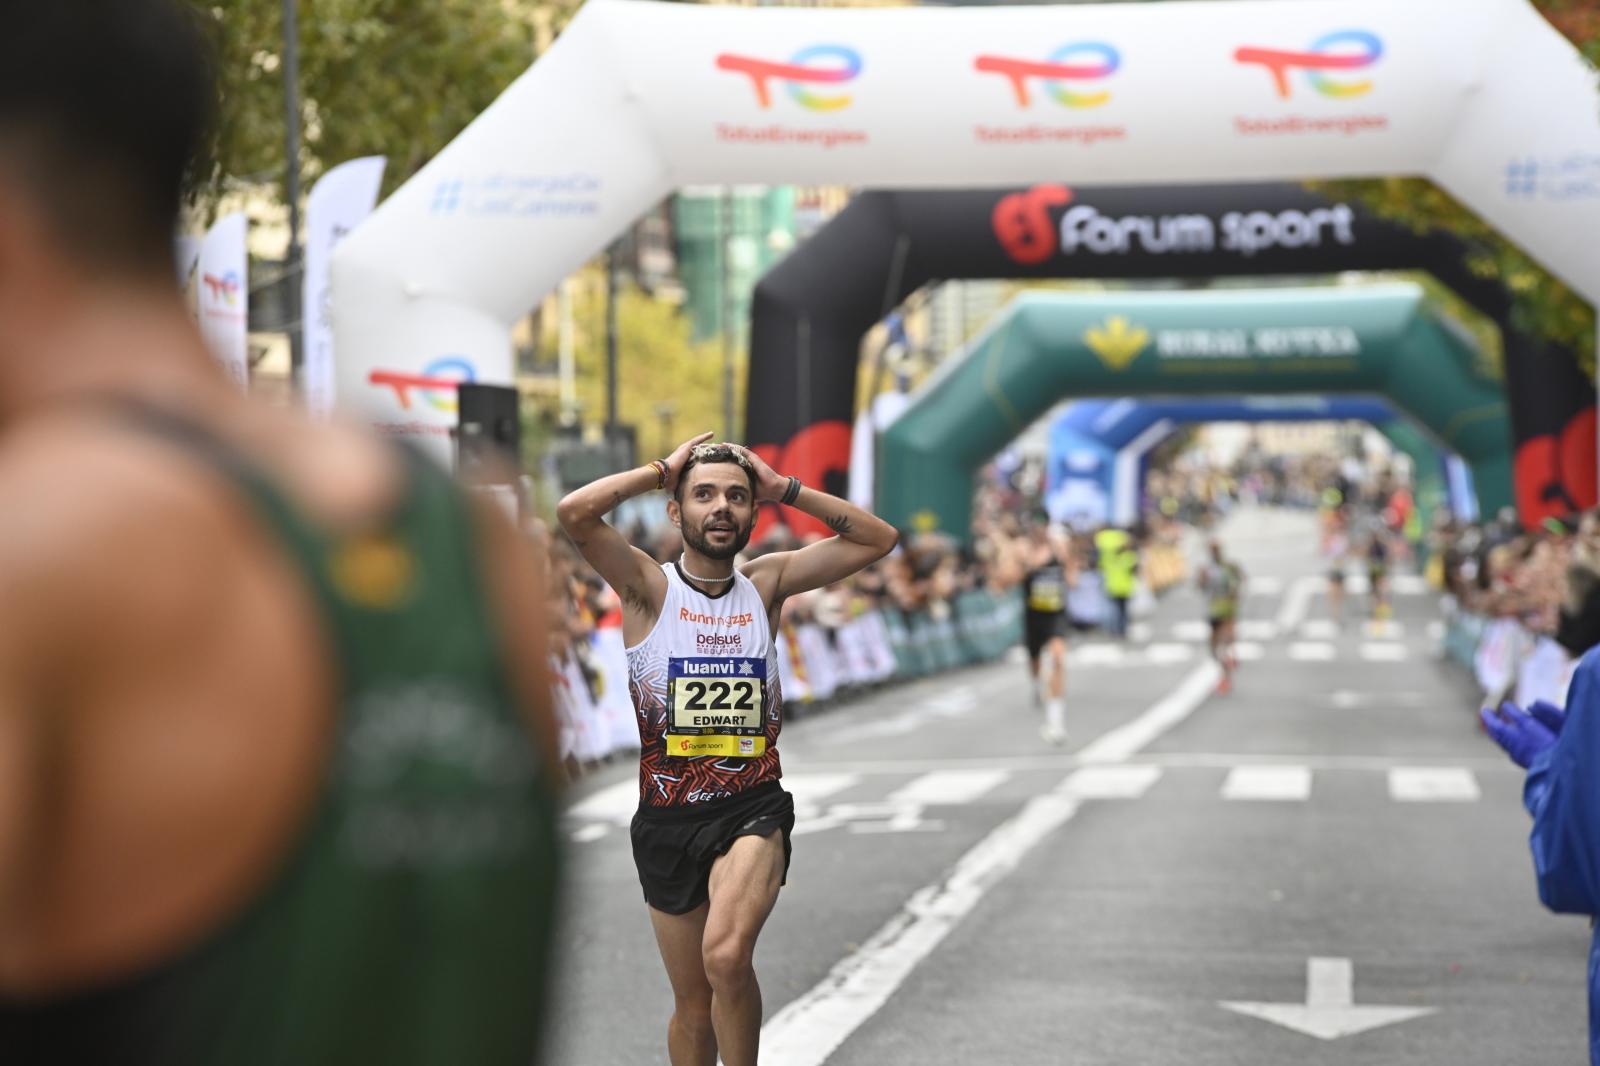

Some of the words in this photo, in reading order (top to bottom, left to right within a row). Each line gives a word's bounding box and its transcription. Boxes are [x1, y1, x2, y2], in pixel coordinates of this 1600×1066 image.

[1220, 203, 1354, 255] sport
[680, 607, 753, 627] Runningzgz
[683, 660, 735, 674] luanvi
[684, 682, 754, 710] 222
[693, 716, 747, 725] EDWART
